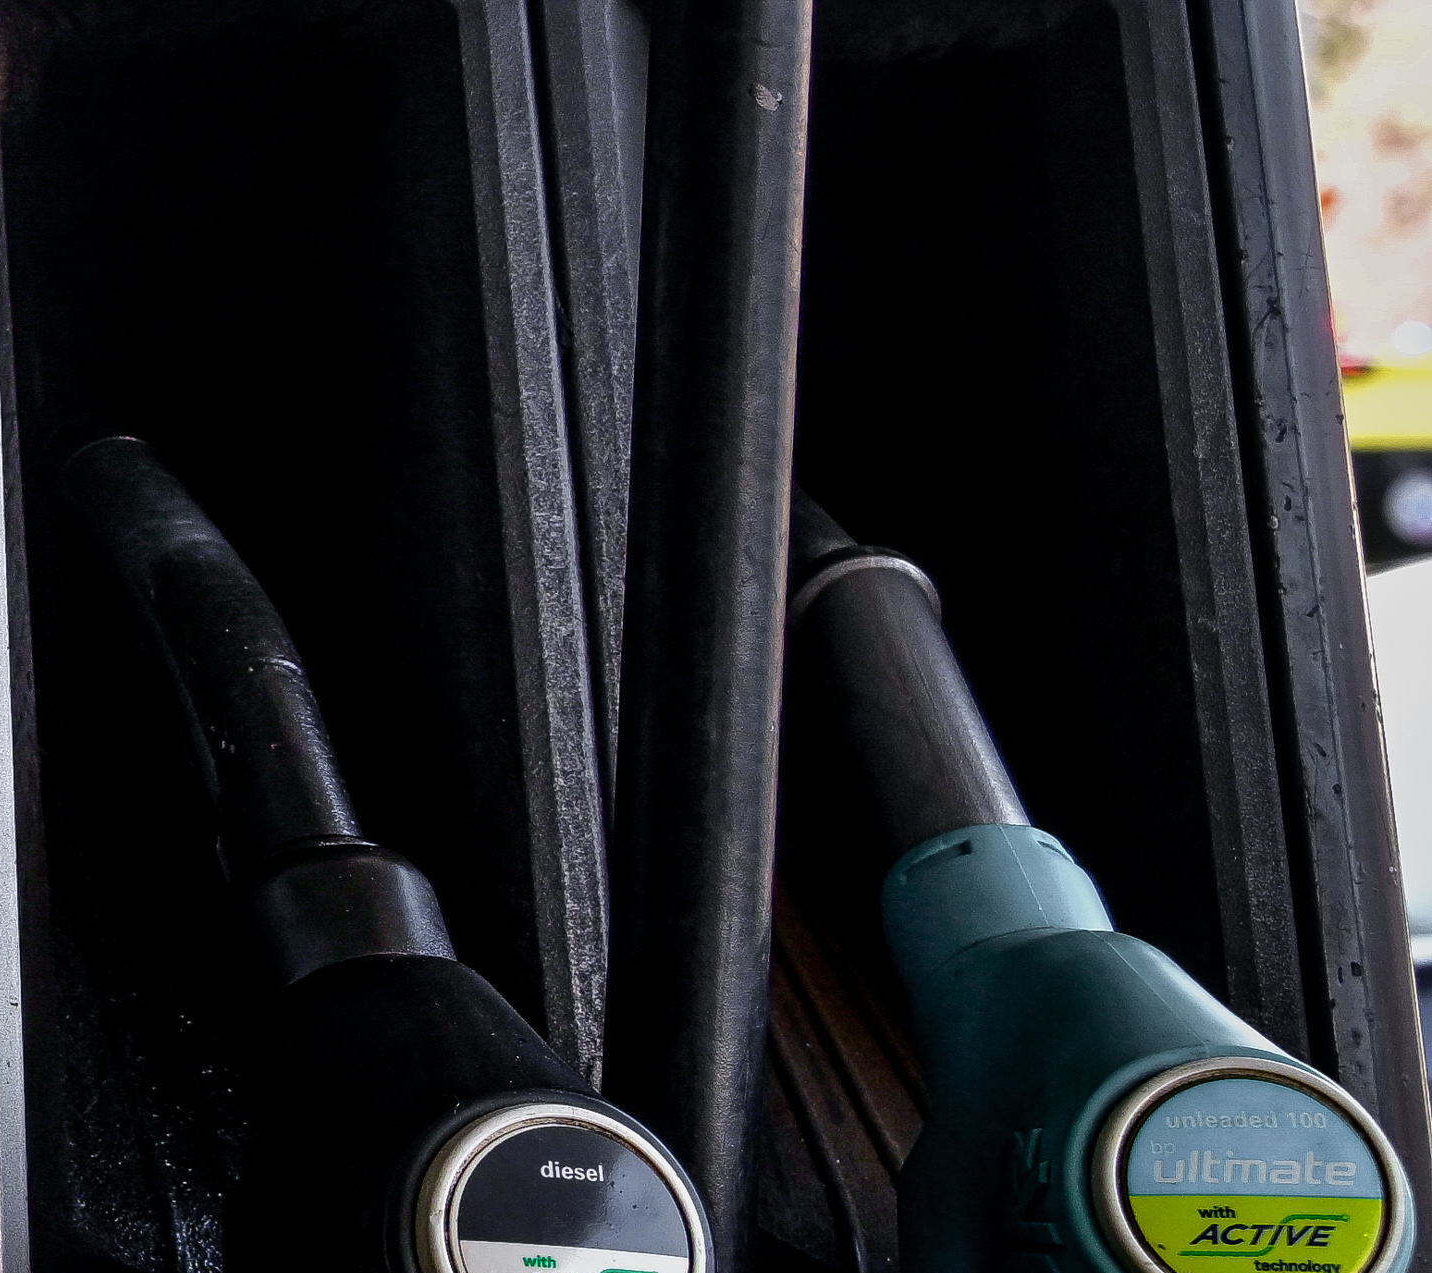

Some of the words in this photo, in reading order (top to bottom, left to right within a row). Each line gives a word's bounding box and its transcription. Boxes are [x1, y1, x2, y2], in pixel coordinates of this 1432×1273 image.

[1165, 1110, 1278, 1128] unleaded
[1287, 1112, 1328, 1128] 100
[540, 1161, 605, 1182] diesel
[1154, 1149, 1357, 1186] ultimate
[1198, 1206, 1236, 1219] with
[1189, 1224, 1337, 1247] ACTIVE
[522, 1255, 557, 1269] with
